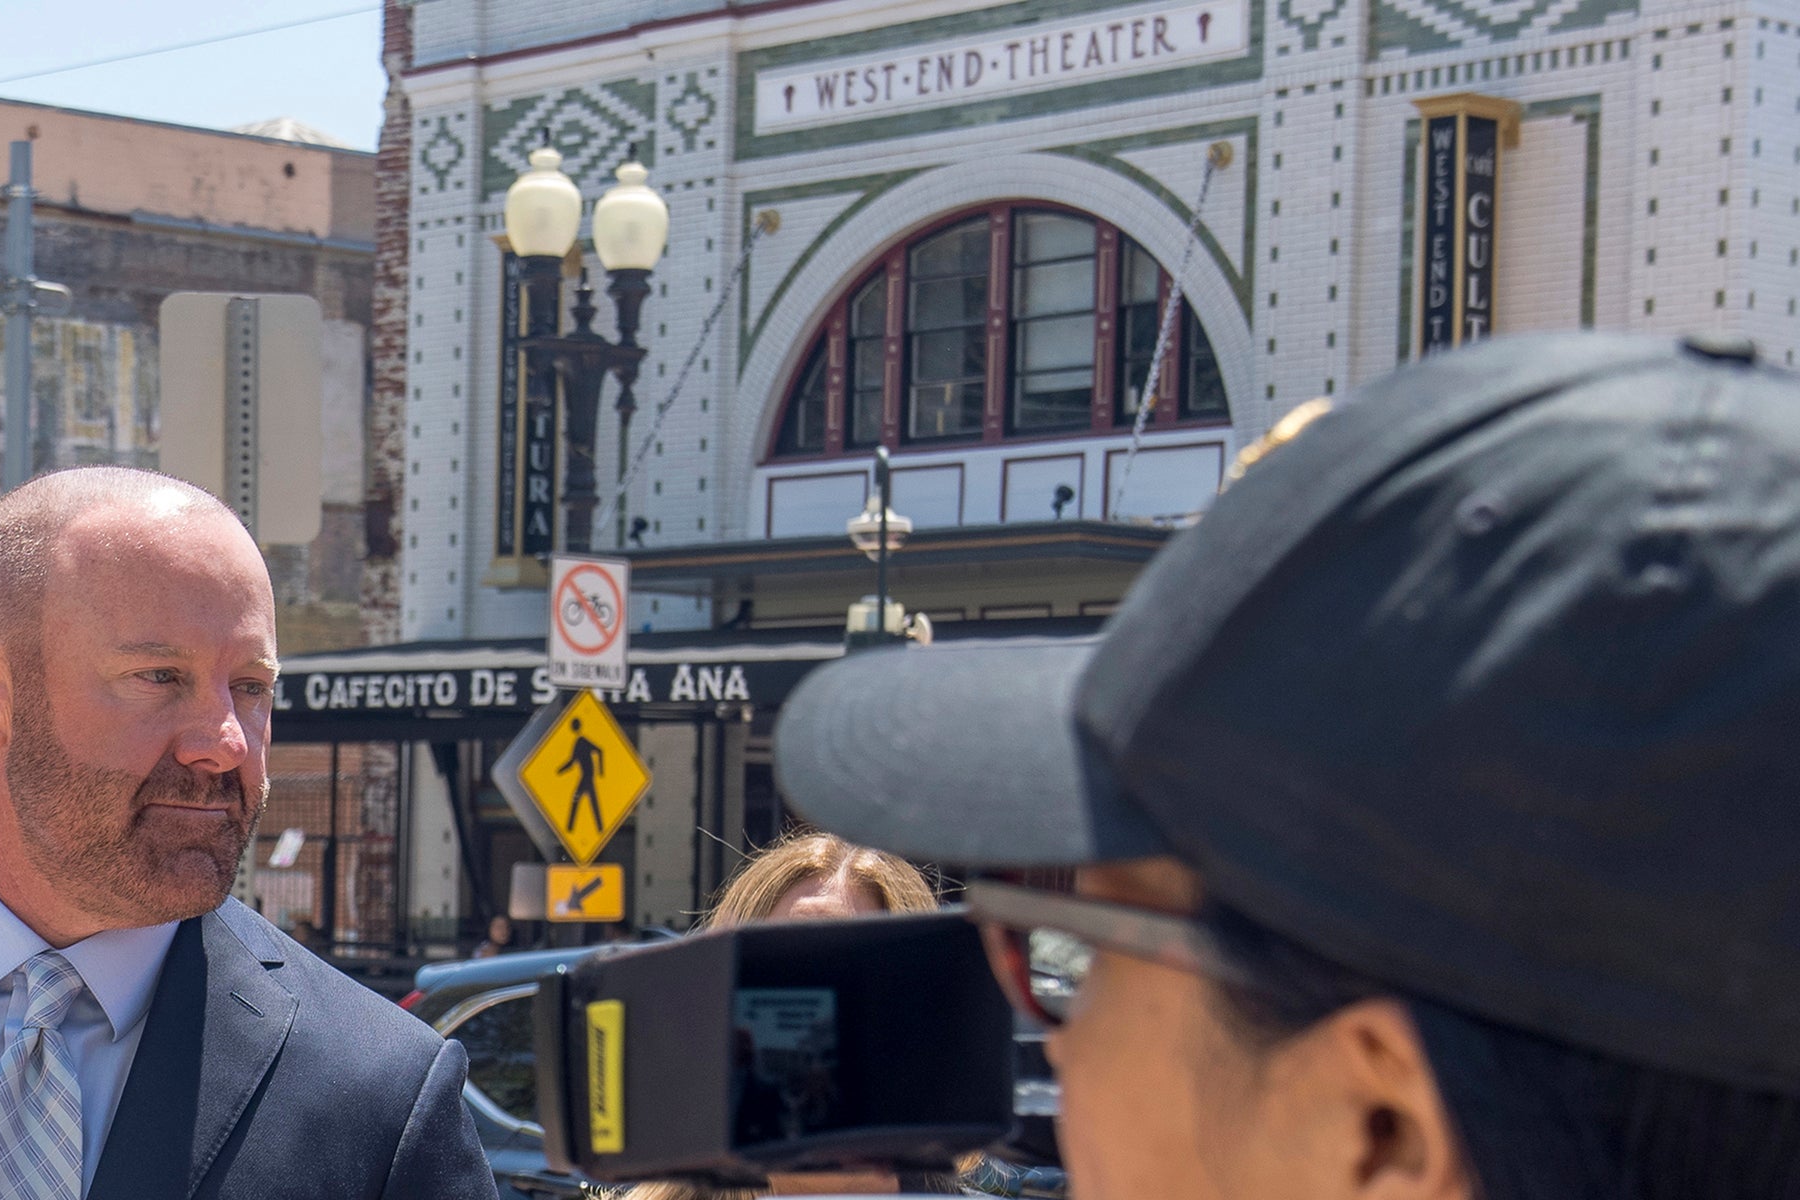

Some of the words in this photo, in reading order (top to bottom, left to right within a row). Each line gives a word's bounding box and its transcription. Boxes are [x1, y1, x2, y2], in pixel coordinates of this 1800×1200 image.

[814, 63, 898, 111] WEST
[916, 51, 985, 96] END
[1005, 16, 1178, 81] THEATER
[304, 672, 458, 711] CAFECITO
[668, 663, 751, 701] ANA
